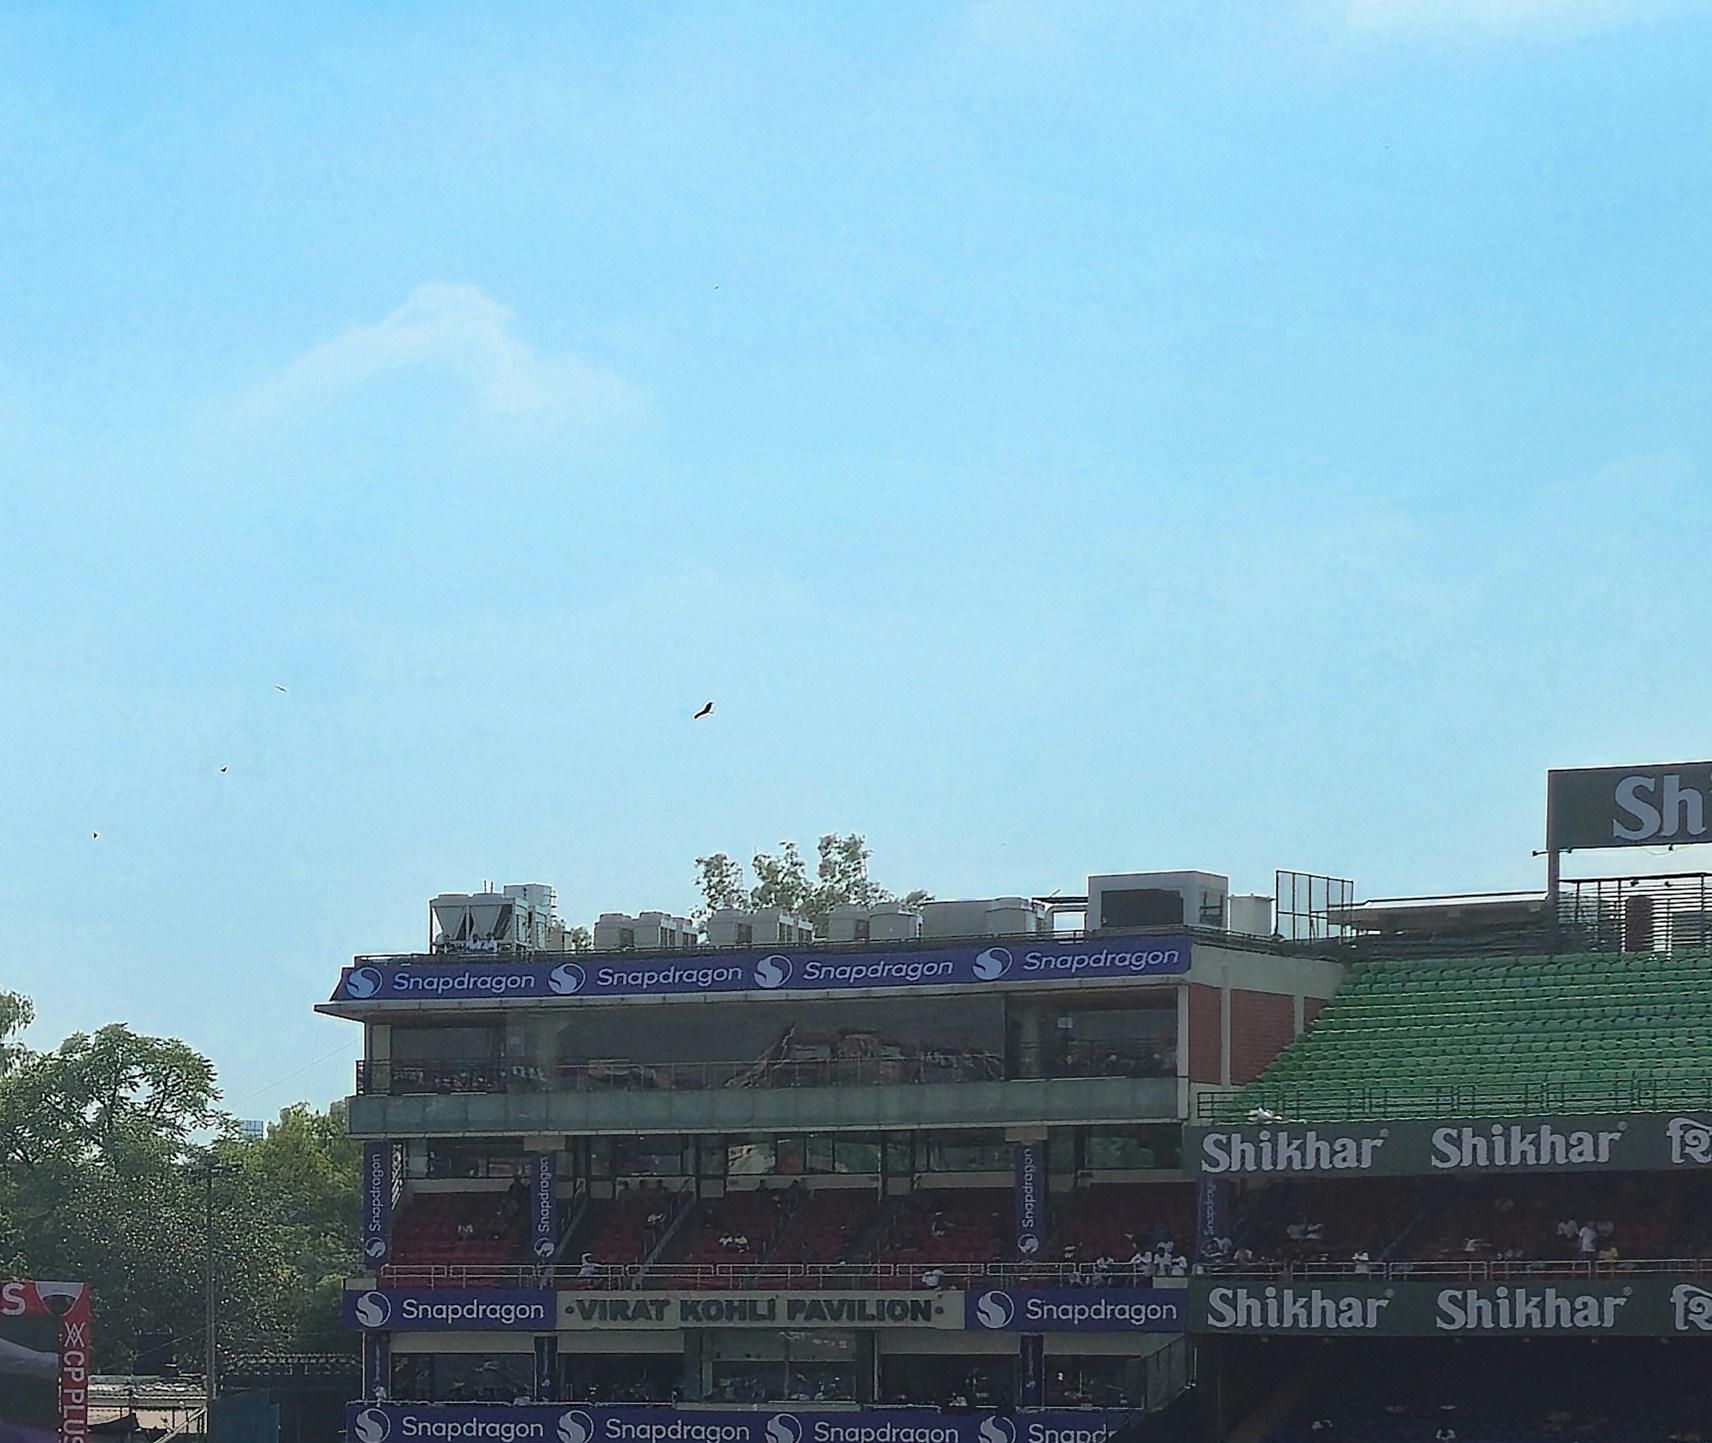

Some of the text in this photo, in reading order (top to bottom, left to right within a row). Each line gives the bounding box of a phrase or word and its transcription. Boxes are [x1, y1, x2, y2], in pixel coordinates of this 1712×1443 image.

[1613, 775, 1712, 840] Sh
[803, 959, 954, 982] Snapdragon
[1023, 948, 1179, 973] Snapdragon
[393, 972, 535, 993] Snapdragon
[597, 966, 743, 990] Snapdragon
[1201, 1127, 1384, 1173] Shikhar
[1431, 1123, 1622, 1169] Shikhar
[370, 1153, 383, 1232] Snapdragon
[539, 1155, 552, 1234] Snapdragon
[1023, 1147, 1035, 1228] Snapdragon
[402, 1299, 544, 1326] Snapdragon
[577, 1299, 933, 1322] VIRAT KOHLI PAVILION
[1026, 1298, 1177, 1326] Snapdragon
[1207, 1286, 1389, 1330] Shikhar
[1436, 1286, 1628, 1331] Shikhar
[63, 1351, 85, 1382] CP
[402, 1416, 544, 1442] Snapdragon
[605, 1418, 751, 1443] Snapdragon
